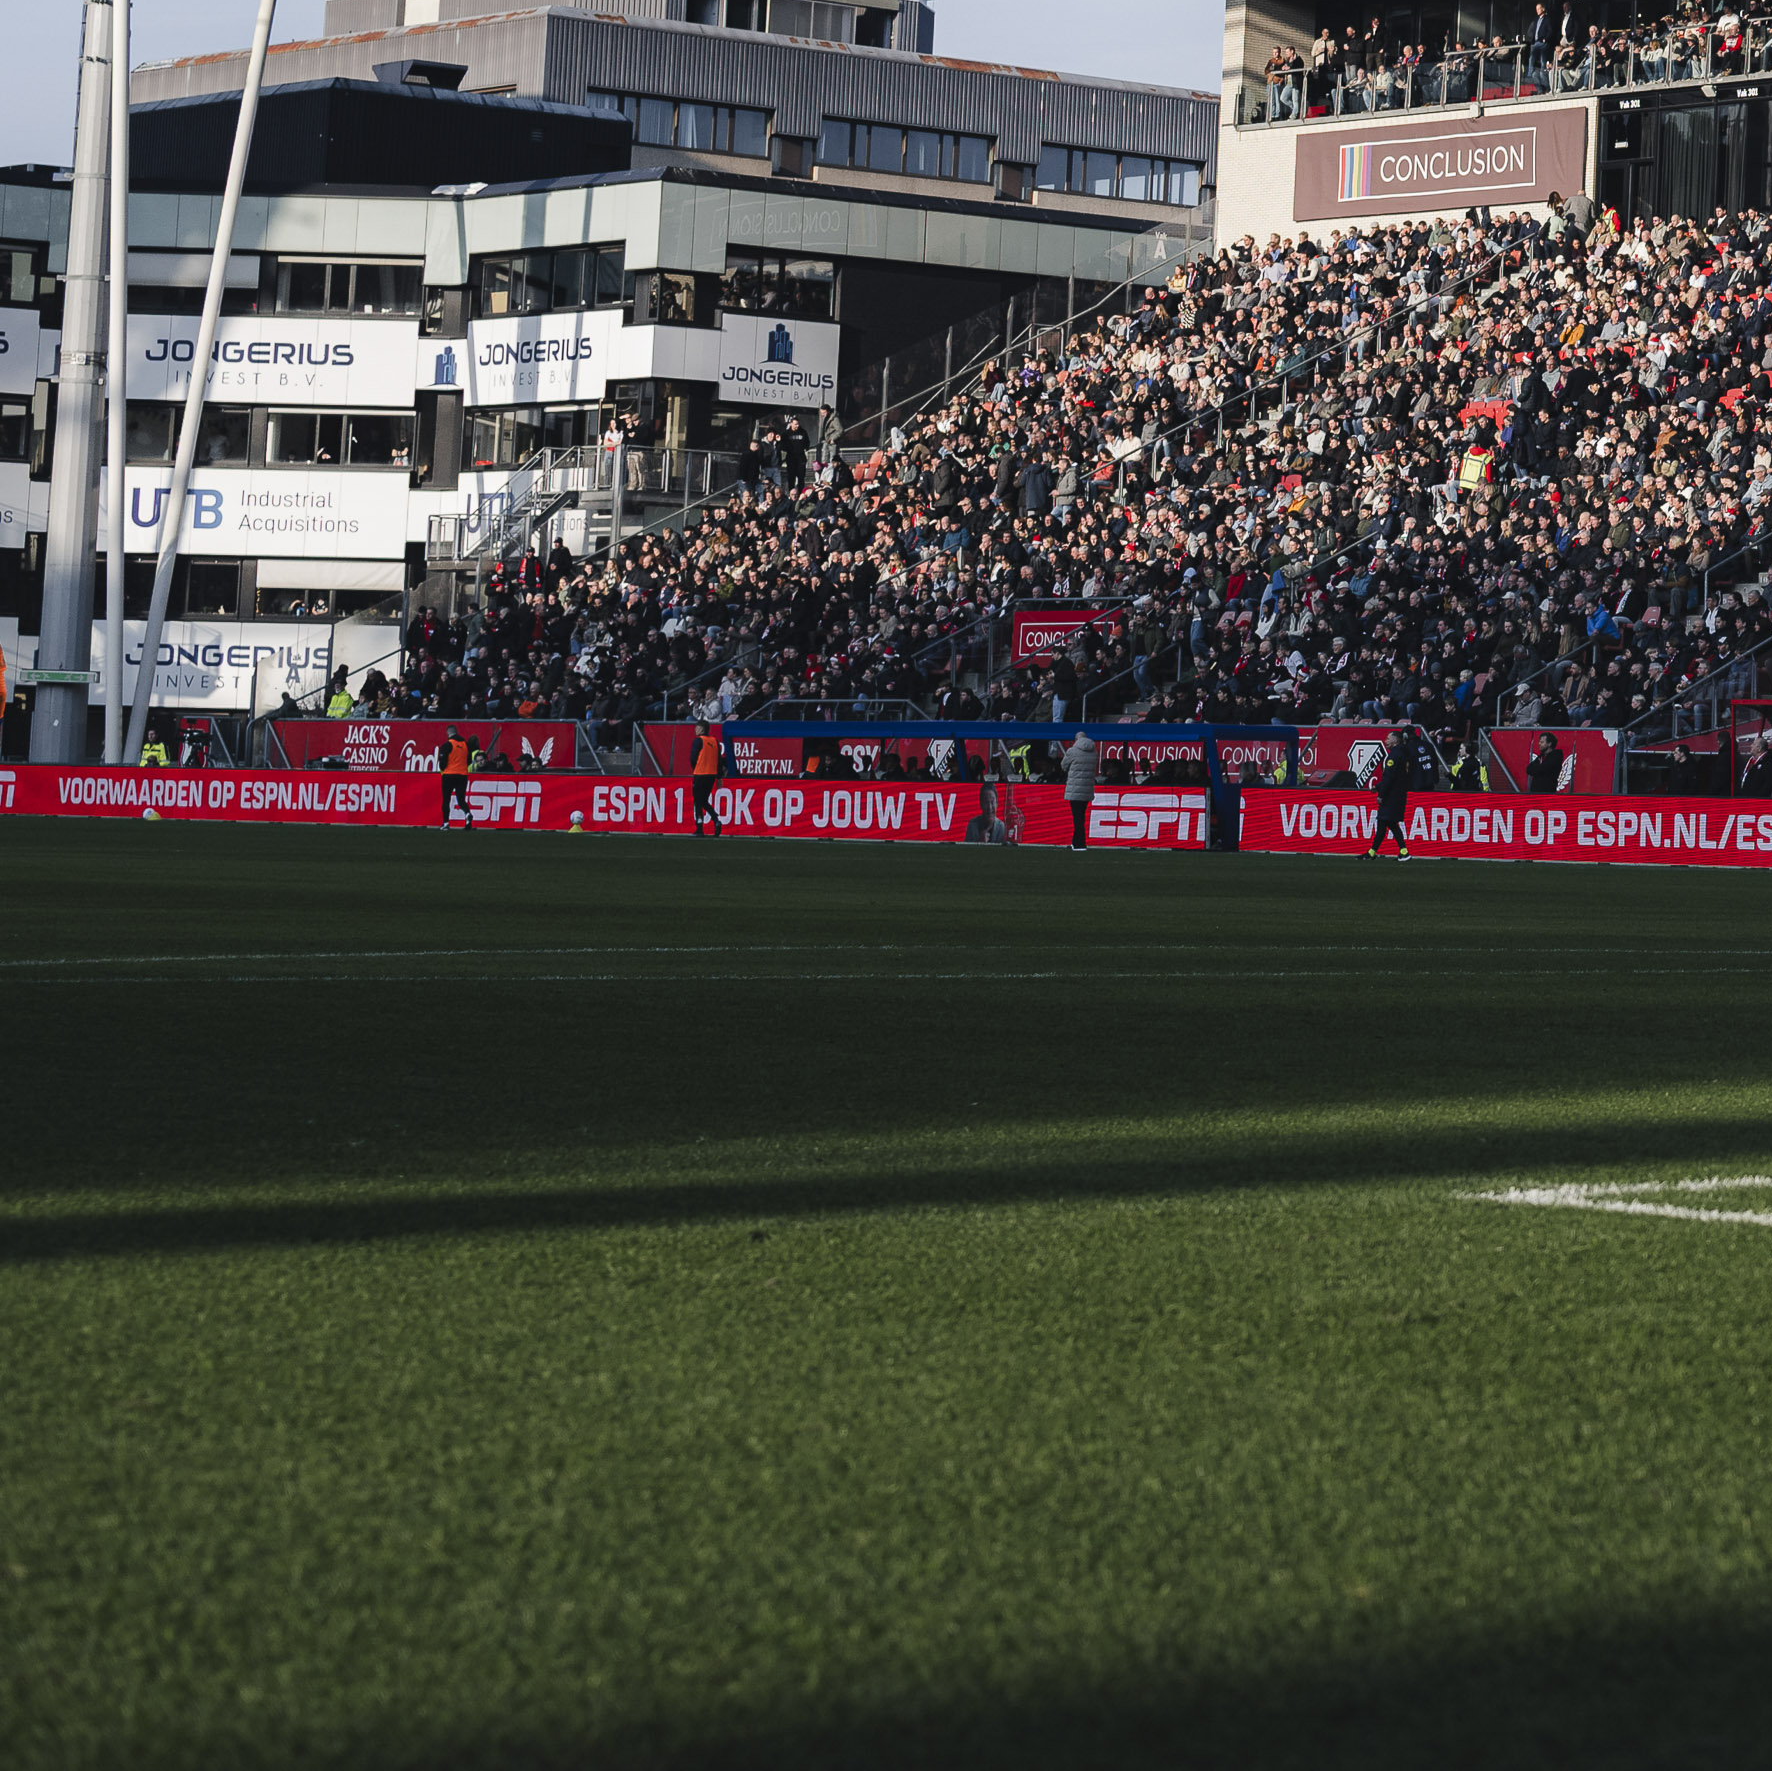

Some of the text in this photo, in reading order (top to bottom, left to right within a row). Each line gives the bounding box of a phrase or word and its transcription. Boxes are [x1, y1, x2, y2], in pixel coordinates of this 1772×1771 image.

[1380, 144, 1525, 183] CONCLUSION
[479, 337, 592, 366] JONGERIUS
[279, 372, 324, 387] B.V.
[493, 369, 575, 389] INVEST B.V.
[722, 366, 834, 389] JONGERIUS
[738, 386, 819, 404] INVEST B.V.
[241, 489, 333, 509] Industrial
[239, 514, 360, 535] Acquisitions
[155, 675, 242, 690] INVEST
[344, 724, 391, 746] JACK'S
[342, 746, 389, 765] CASINO
[1357, 748, 1364, 765] F
[58, 777, 397, 813] VOORWAARDEN OP ESPN.NL/ESPN1
[593, 786, 666, 823] ESPN
[675, 788, 685, 824] 1
[764, 789, 804, 827] OP
[812, 790, 907, 829] JOUW
[915, 792, 957, 831] TV
[1524, 809, 1567, 845] OP
